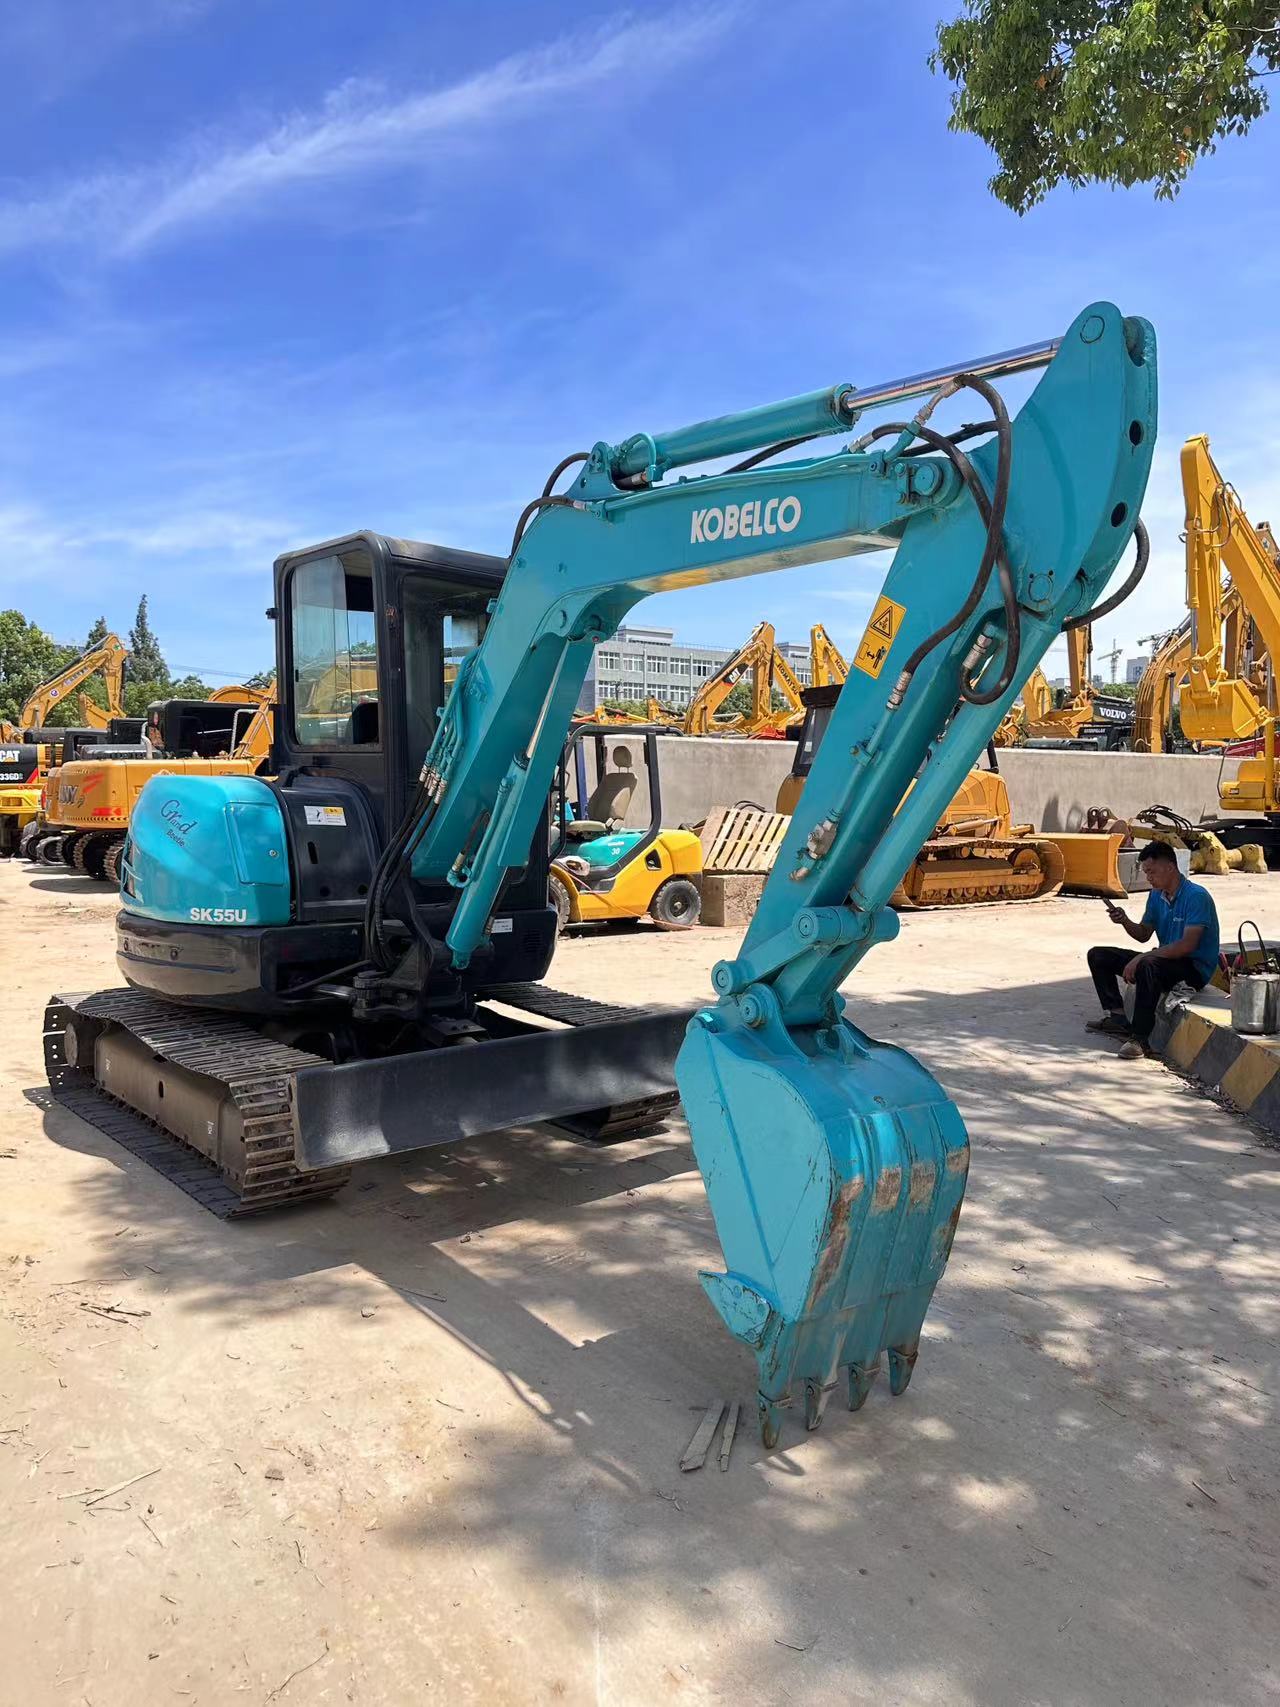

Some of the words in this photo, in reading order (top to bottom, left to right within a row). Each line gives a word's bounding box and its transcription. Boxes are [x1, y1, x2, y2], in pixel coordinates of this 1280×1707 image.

[690, 496, 801, 543] KOBELCO
[729, 667, 741, 683] CAT
[777, 663, 799, 695] KOMATSU
[1099, 707, 1127, 719] VOLVO
[0, 750, 20, 762] CAT
[160, 799, 198, 835] Grand
[190, 907, 247, 922] SK55U
